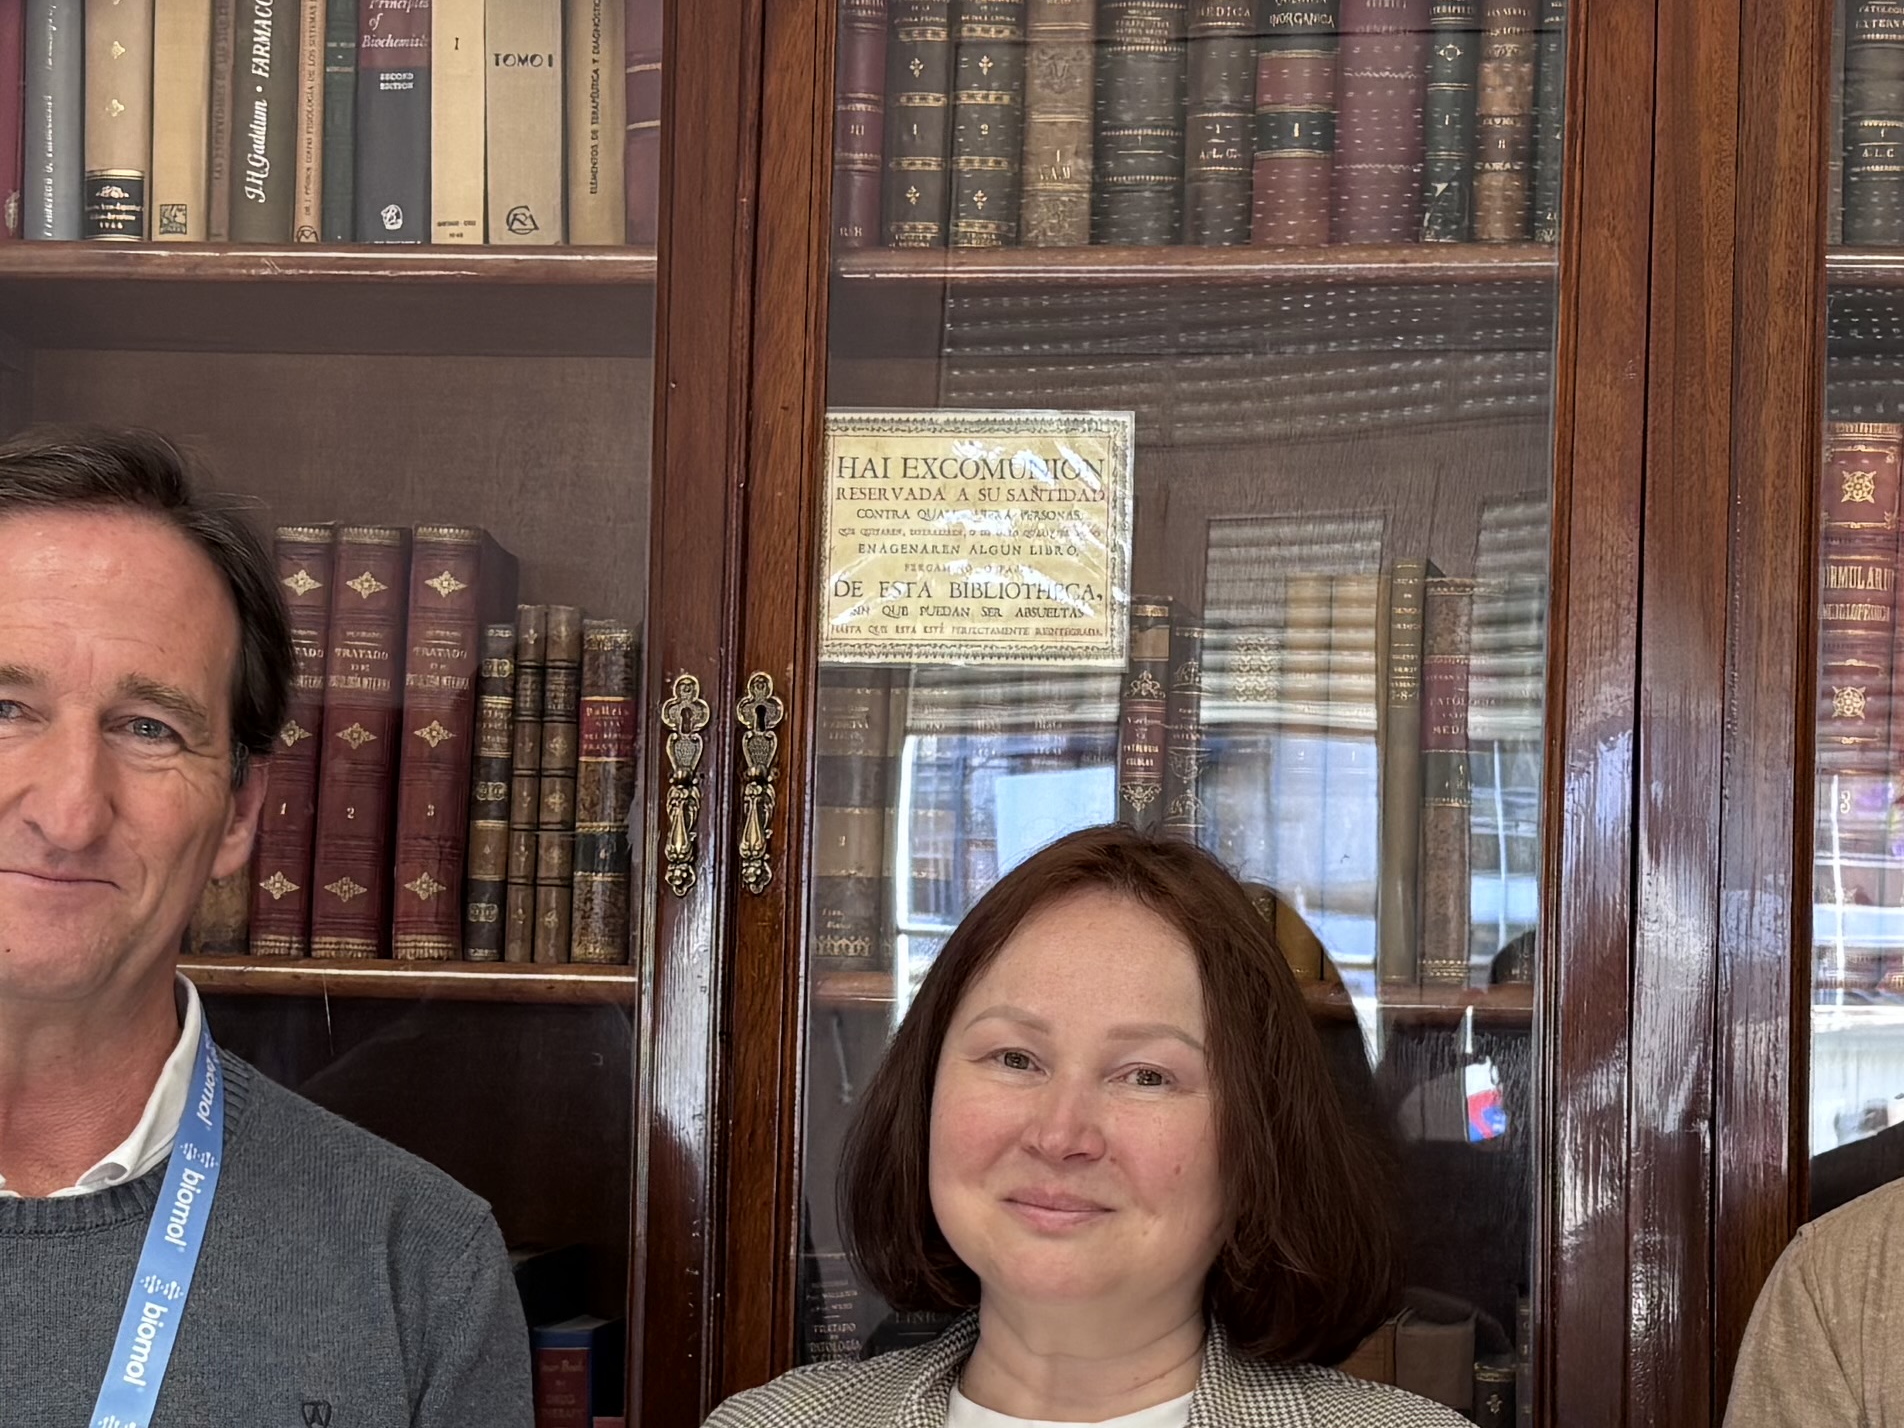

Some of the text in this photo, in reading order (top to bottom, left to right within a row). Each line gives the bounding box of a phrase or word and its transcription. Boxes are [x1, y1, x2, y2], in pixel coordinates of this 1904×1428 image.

[368, 13, 384, 31] of
[493, 53, 543, 68] TOMO
[837, 456, 1104, 480] HAI EXCOMUNION
[836, 486, 1001, 502] RESERVADA A SU
[856, 509, 910, 520] CONTRA
[969, 544, 1022, 555] ALGUN
[834, 580, 863, 598] DE
[879, 581, 933, 598] ESTA
[981, 606, 1003, 618] SER
[1014, 606, 1085, 618] ABSUELTAS
[334, 648, 388, 661] TRATADO
[413, 647, 467, 660] TRATADO
[1840, 790, 1852, 813] 3
[346, 807, 355, 820] 2
[427, 804, 435, 817] 3
[165, 1167, 205, 1246] biomol
[124, 1302, 169, 1386] biomol
